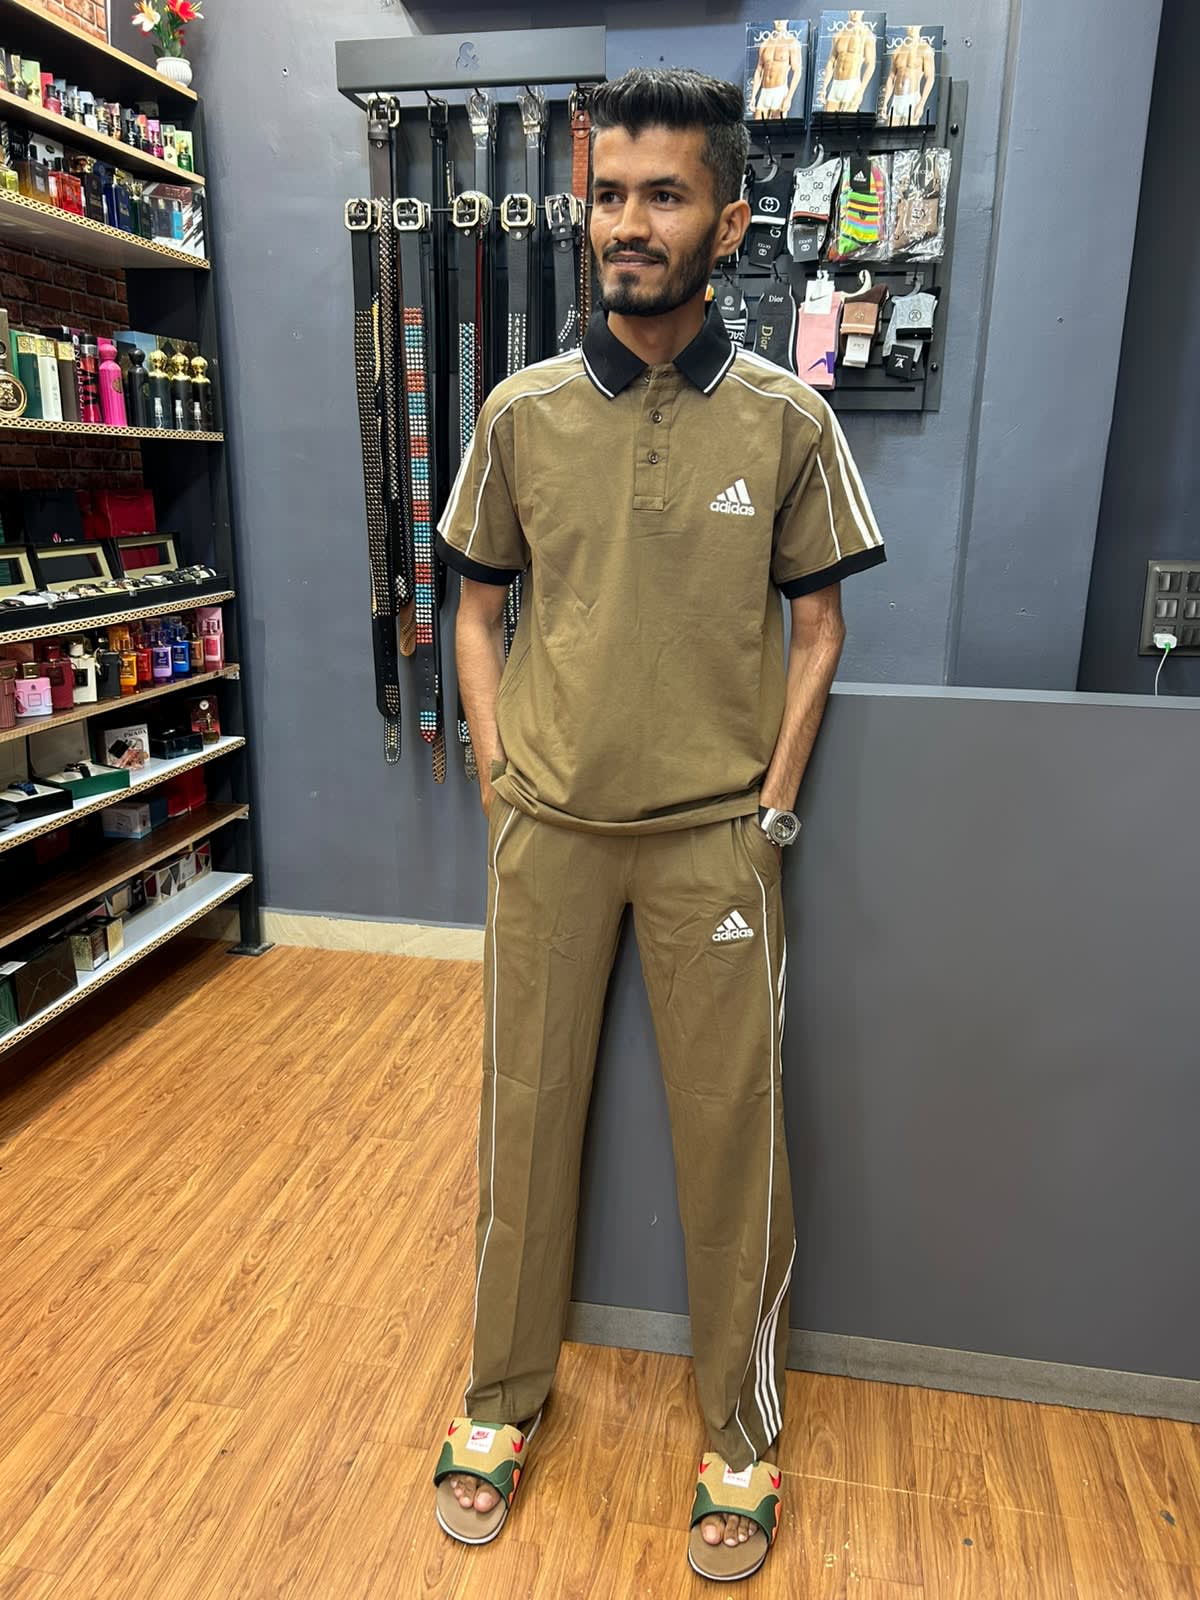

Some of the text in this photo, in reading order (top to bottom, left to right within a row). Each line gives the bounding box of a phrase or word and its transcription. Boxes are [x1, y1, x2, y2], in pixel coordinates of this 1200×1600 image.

[827, 20, 878, 32] JOCEY
[886, 35, 936, 49] JOCEY
[768, 295, 784, 303] Dior
[760, 325, 774, 350] Dior
[710, 500, 756, 517] adidas
[712, 928, 754, 942] adidas
